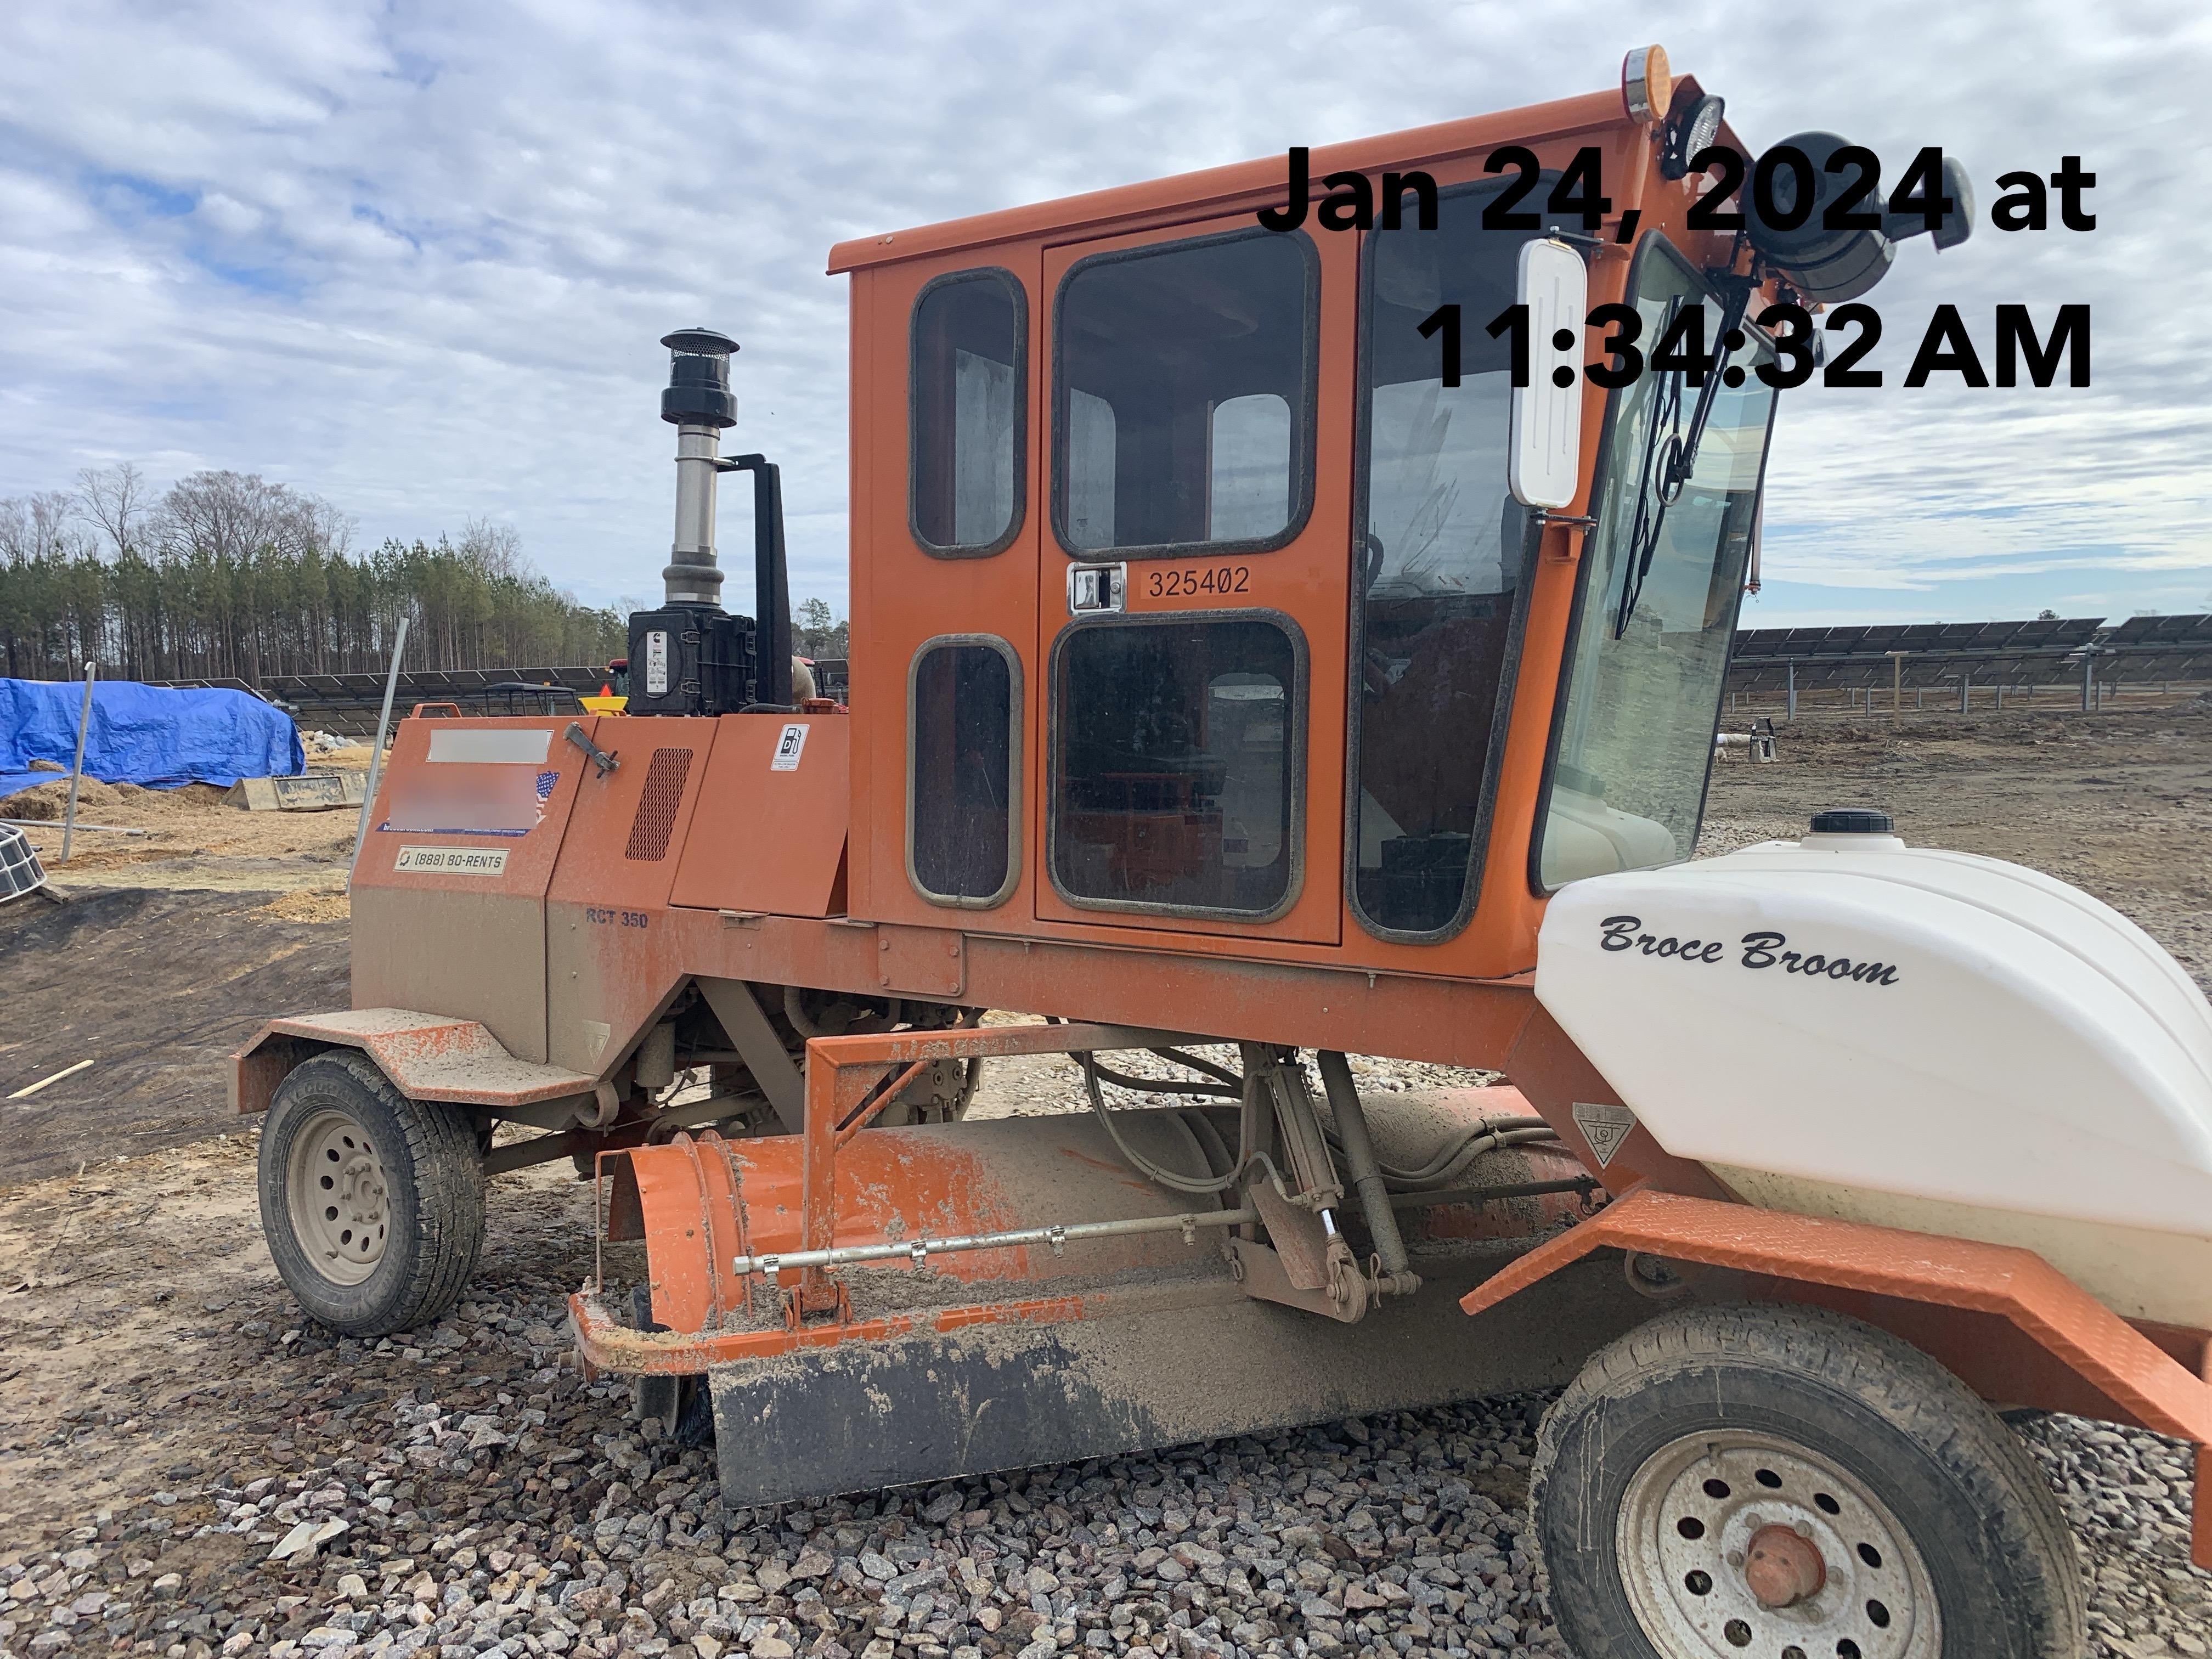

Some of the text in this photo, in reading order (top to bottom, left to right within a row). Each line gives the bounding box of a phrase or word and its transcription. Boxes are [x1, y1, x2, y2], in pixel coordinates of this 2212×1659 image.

[1149, 567, 1249, 597] 325402
[415, 853, 502, 868] (888) 80-RENTS
[586, 908, 647, 928] RCT 350
[1600, 916, 1899, 986] Broce Broom
